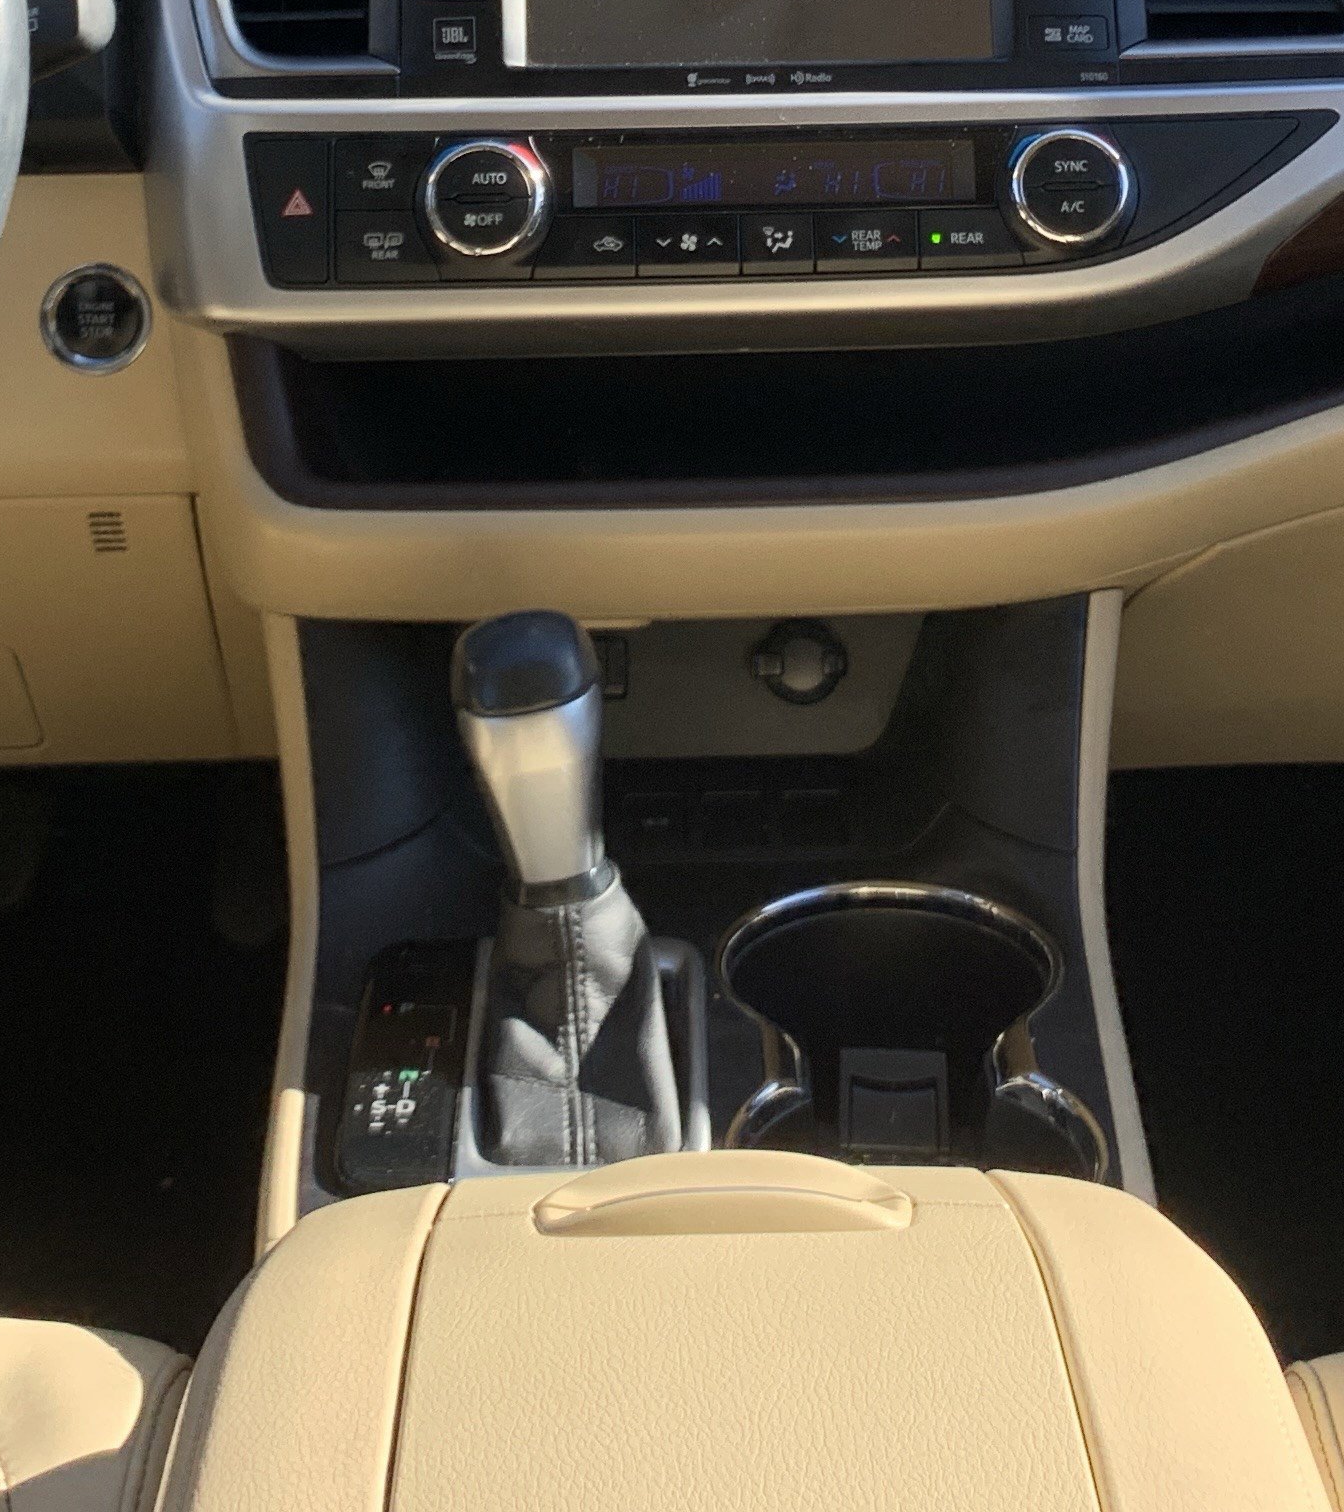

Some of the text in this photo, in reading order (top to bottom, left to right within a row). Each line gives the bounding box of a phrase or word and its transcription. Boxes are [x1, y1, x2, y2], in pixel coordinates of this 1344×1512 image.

[441, 26, 469, 44] JBL
[1069, 25, 1090, 34] MAP
[1067, 34, 1093, 43] CARD
[805, 72, 832, 83] Radio
[1055, 160, 1088, 173] SYNC
[362, 179, 395, 189] FRONT
[471, 172, 507, 185] AUTO
[1061, 200, 1085, 213] A/C
[477, 213, 503, 226] OFF
[851, 230, 882, 240] REAR
[951, 232, 984, 245] REAR
[852, 240, 884, 251] TEMP
[371, 249, 398, 260] REAR
